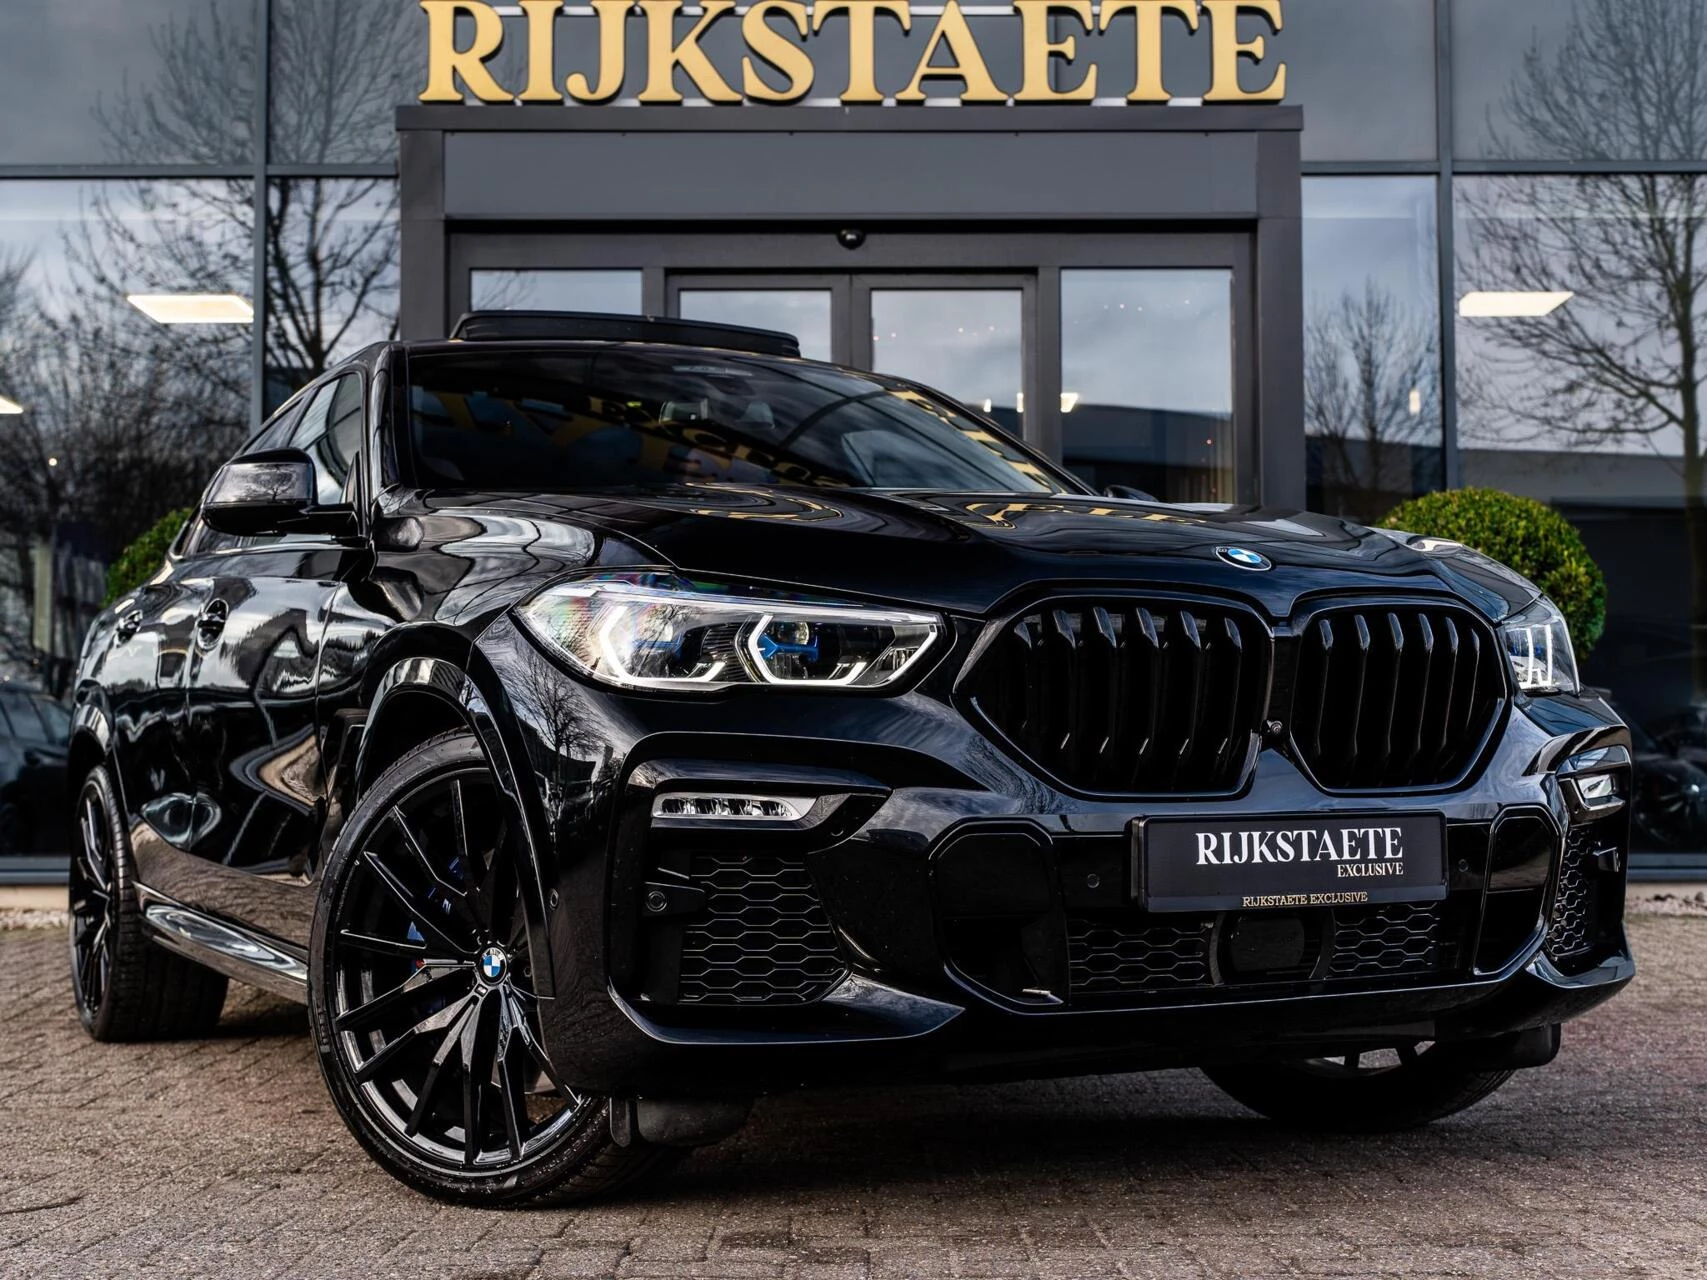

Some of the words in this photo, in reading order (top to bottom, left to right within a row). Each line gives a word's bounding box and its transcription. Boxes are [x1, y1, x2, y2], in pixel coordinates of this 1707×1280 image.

[418, 0, 1287, 102] RIJKSTAETE
[1195, 827, 1403, 865] RIJKSTAETE
[1337, 862, 1403, 878] EXCLUSIVE
[1242, 893, 1307, 907] RIJKSTAETE
[1309, 891, 1368, 905] EXCLUSIVE
